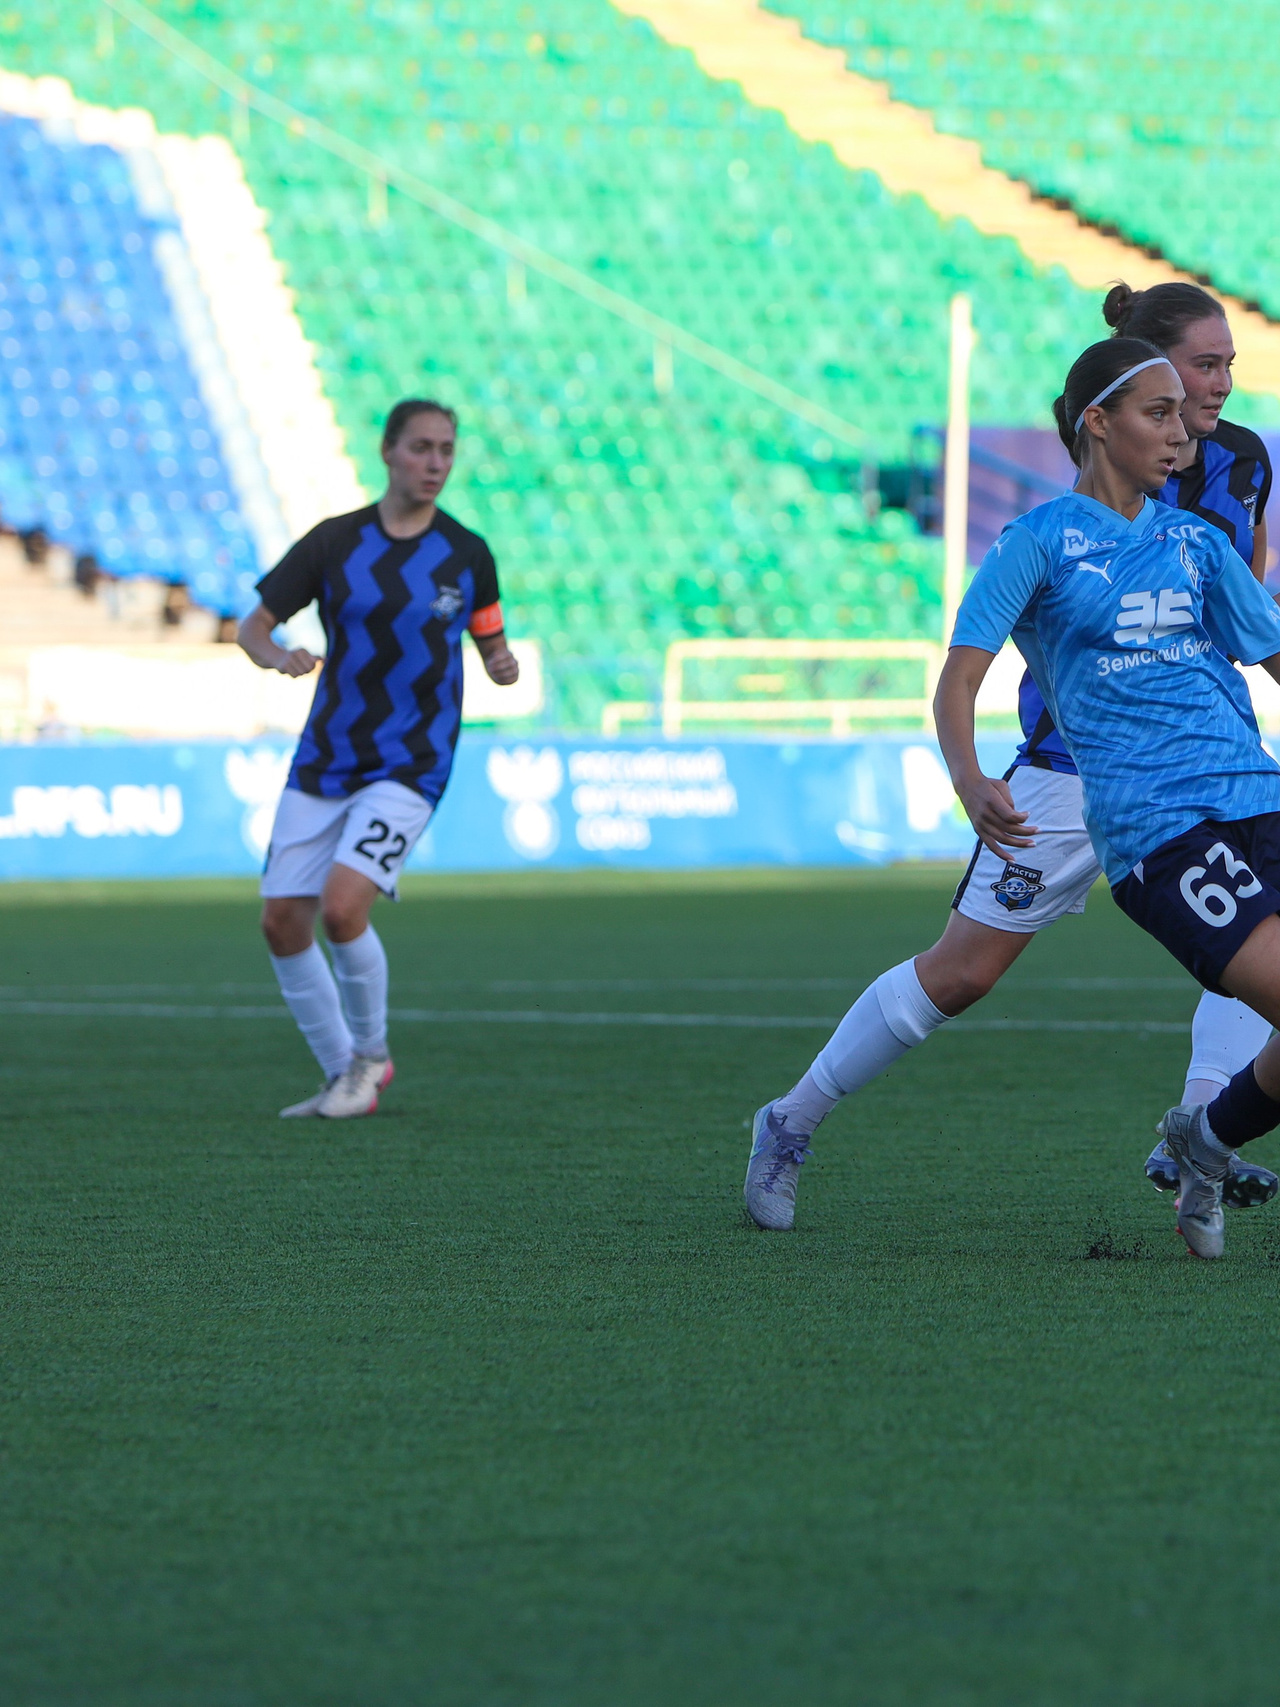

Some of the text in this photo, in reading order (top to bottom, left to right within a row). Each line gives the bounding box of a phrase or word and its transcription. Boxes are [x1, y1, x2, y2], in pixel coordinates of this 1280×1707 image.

[1096, 638, 1211, 676] Земский бнк
[354, 819, 407, 873] 22
[1008, 865, 1038, 879] МАСТЕР
[1179, 841, 1263, 927] 63
